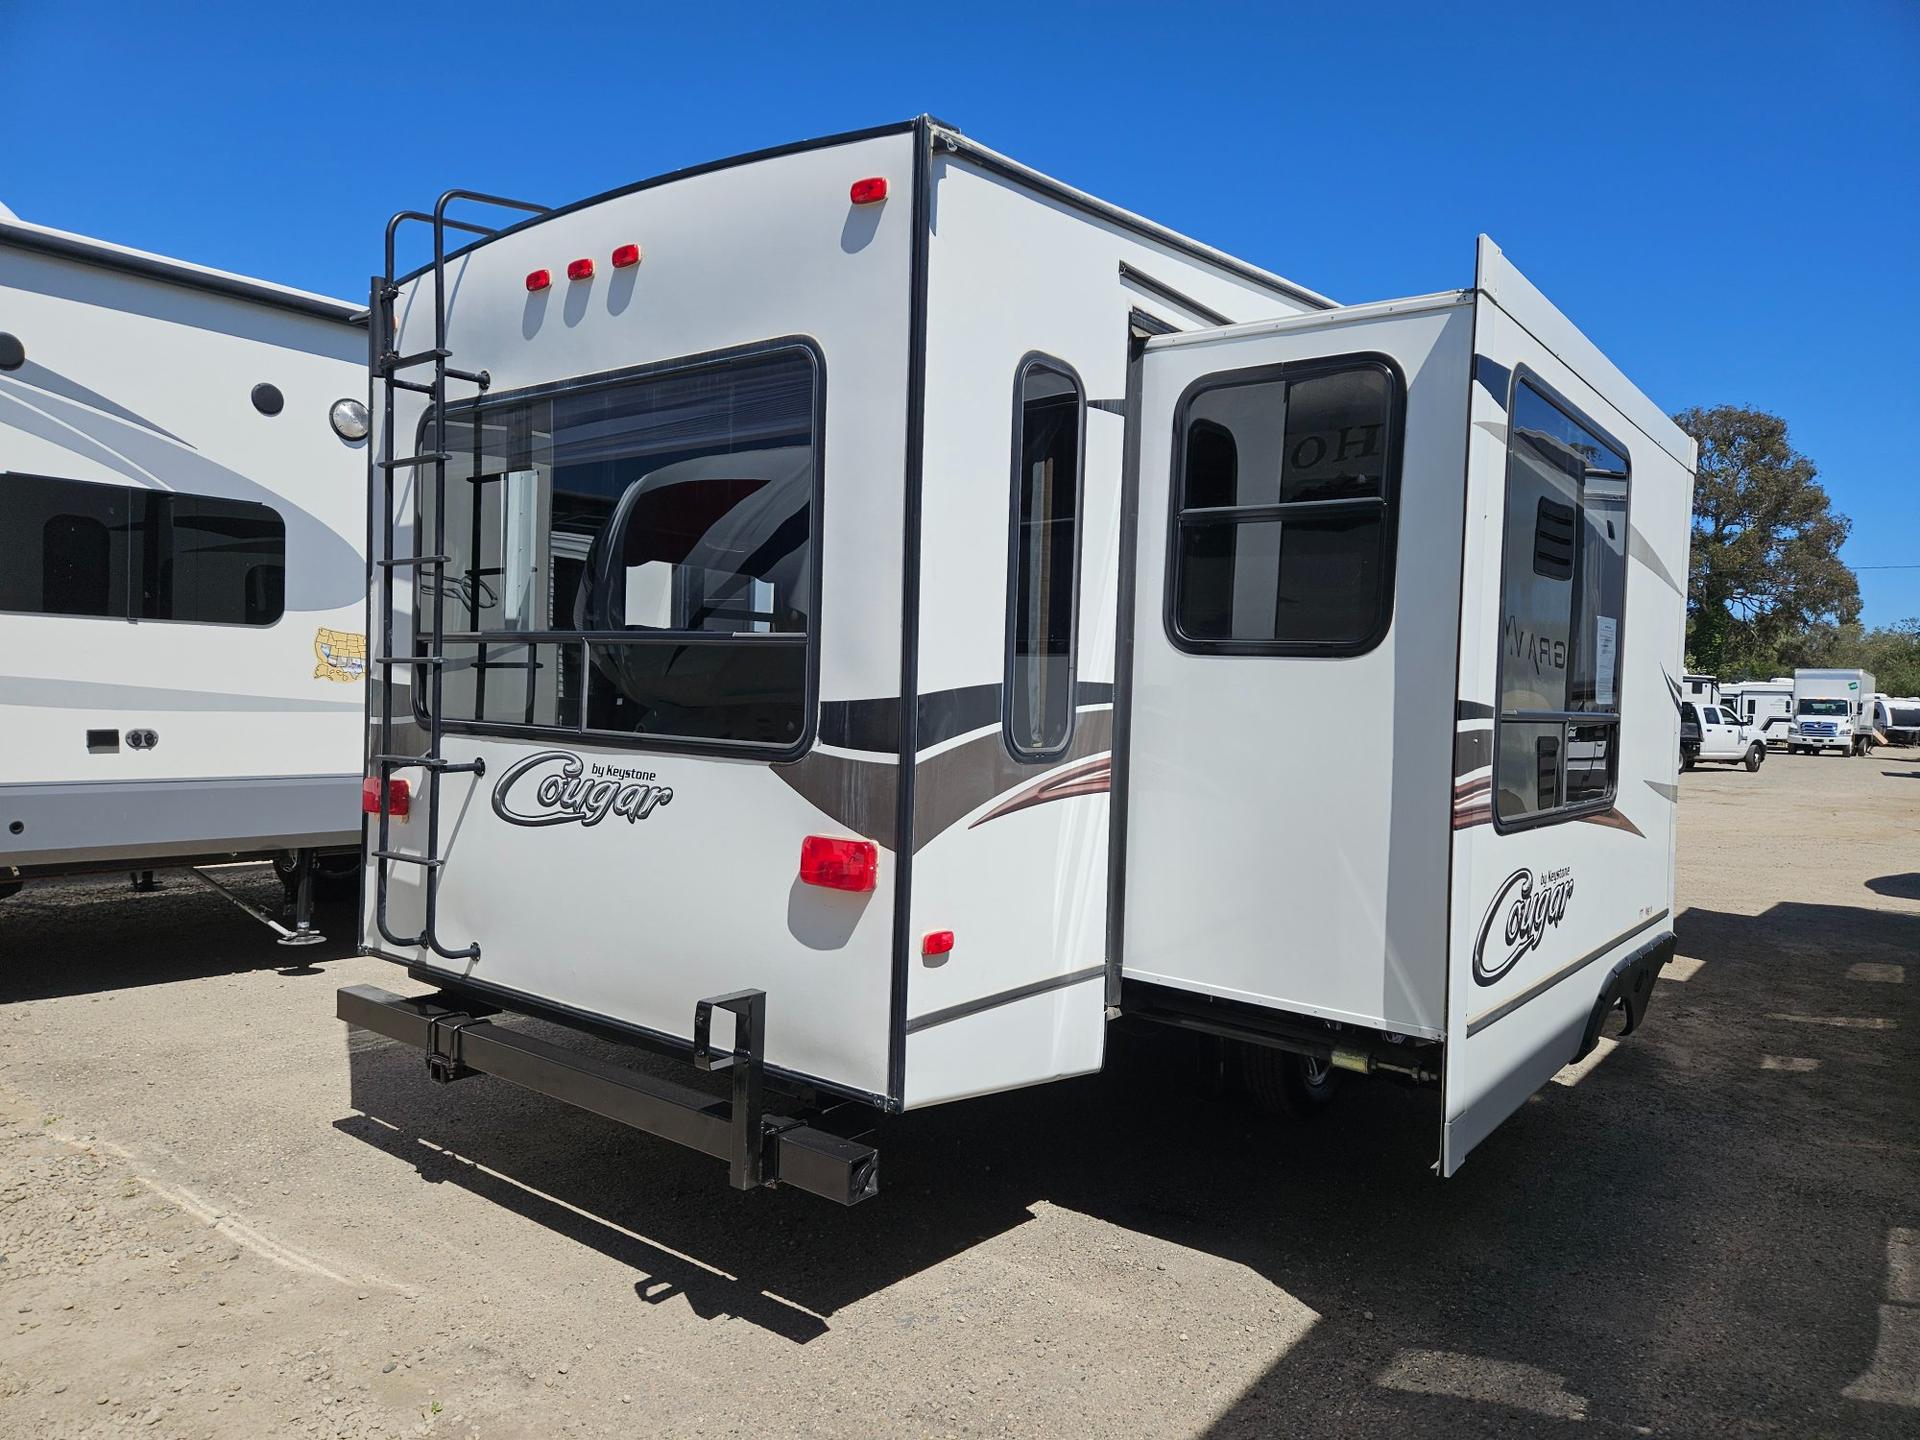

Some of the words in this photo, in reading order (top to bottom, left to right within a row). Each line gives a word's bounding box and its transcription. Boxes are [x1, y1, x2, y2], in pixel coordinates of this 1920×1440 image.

[491, 750, 674, 827] Cougar
[591, 763, 604, 777] by
[607, 764, 656, 781] Keystone
[1540, 872, 1547, 887] by
[1548, 866, 1570, 884] Keystone
[1472, 867, 1574, 987] Cougar
